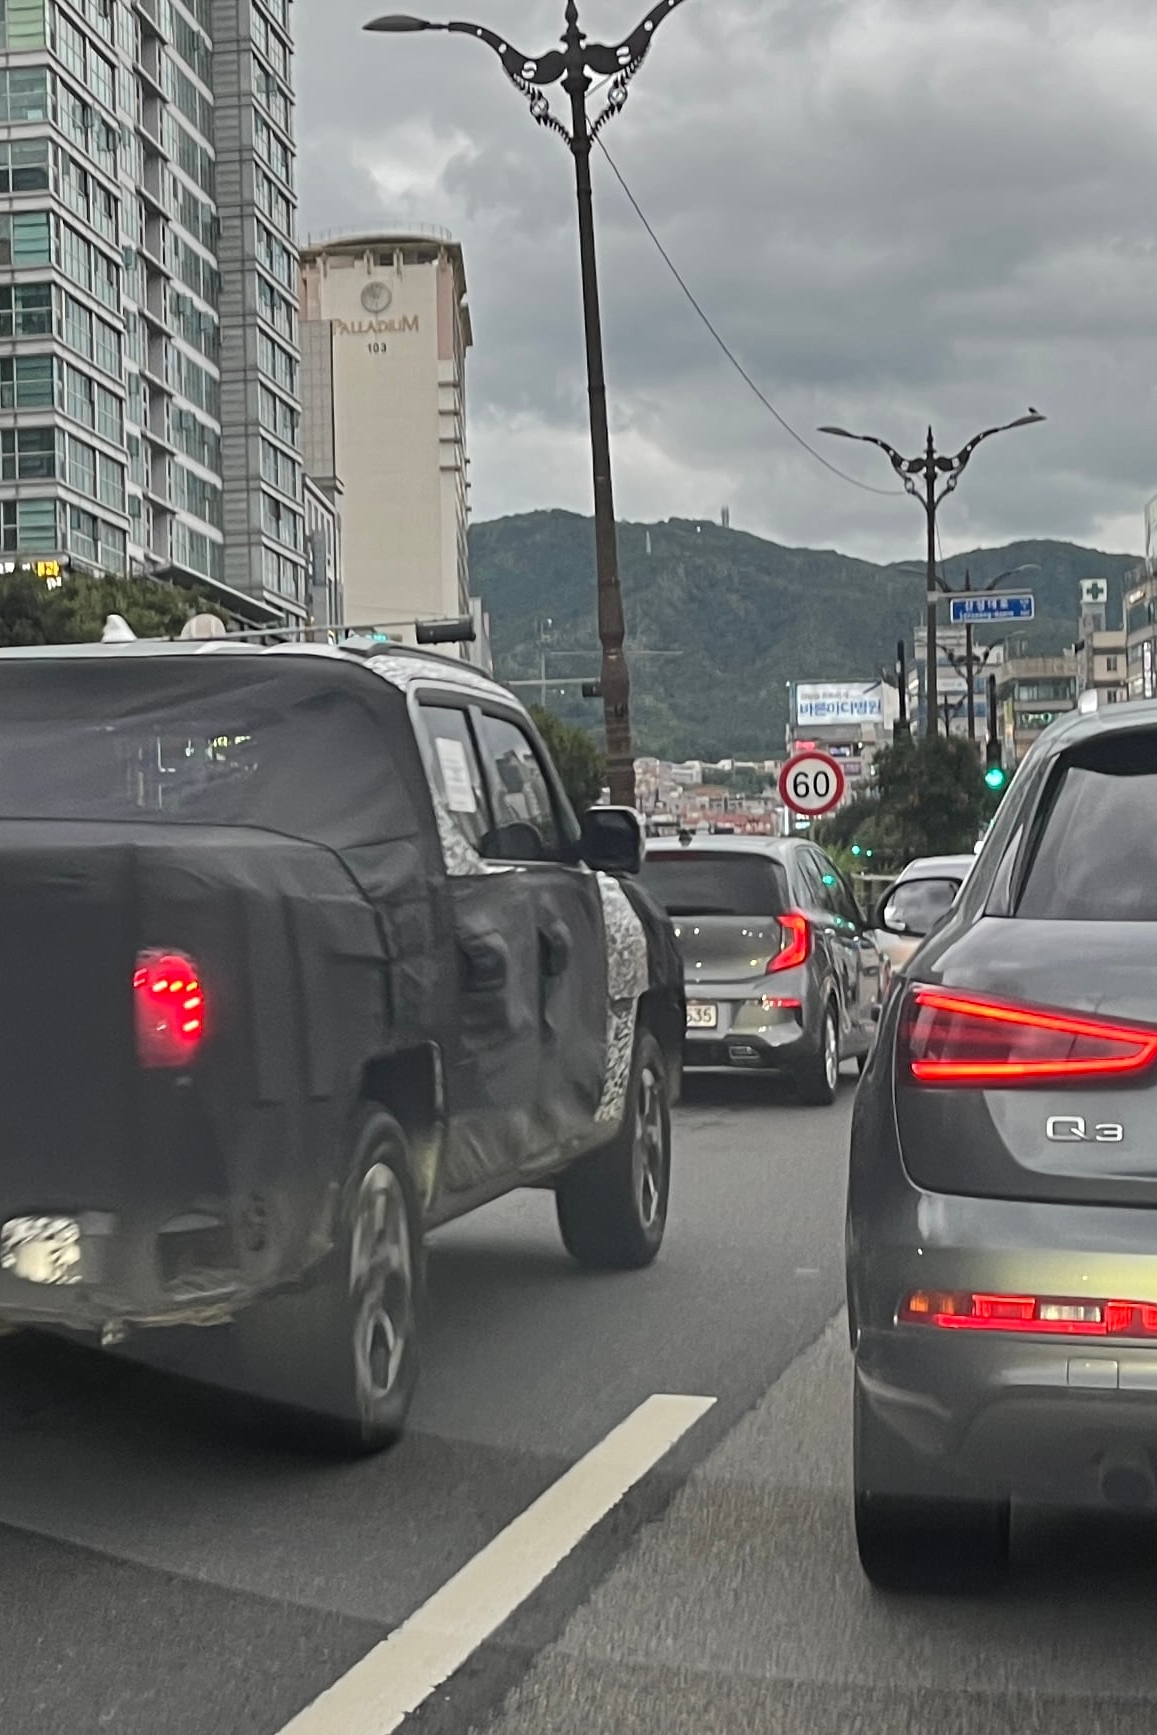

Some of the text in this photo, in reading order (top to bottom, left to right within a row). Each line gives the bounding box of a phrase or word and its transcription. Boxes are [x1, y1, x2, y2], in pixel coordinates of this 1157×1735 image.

[333, 313, 420, 336] PALLADIUM
[367, 342, 388, 354] 103
[792, 771, 831, 799] 60
[1045, 1115, 1124, 1142] Q3
